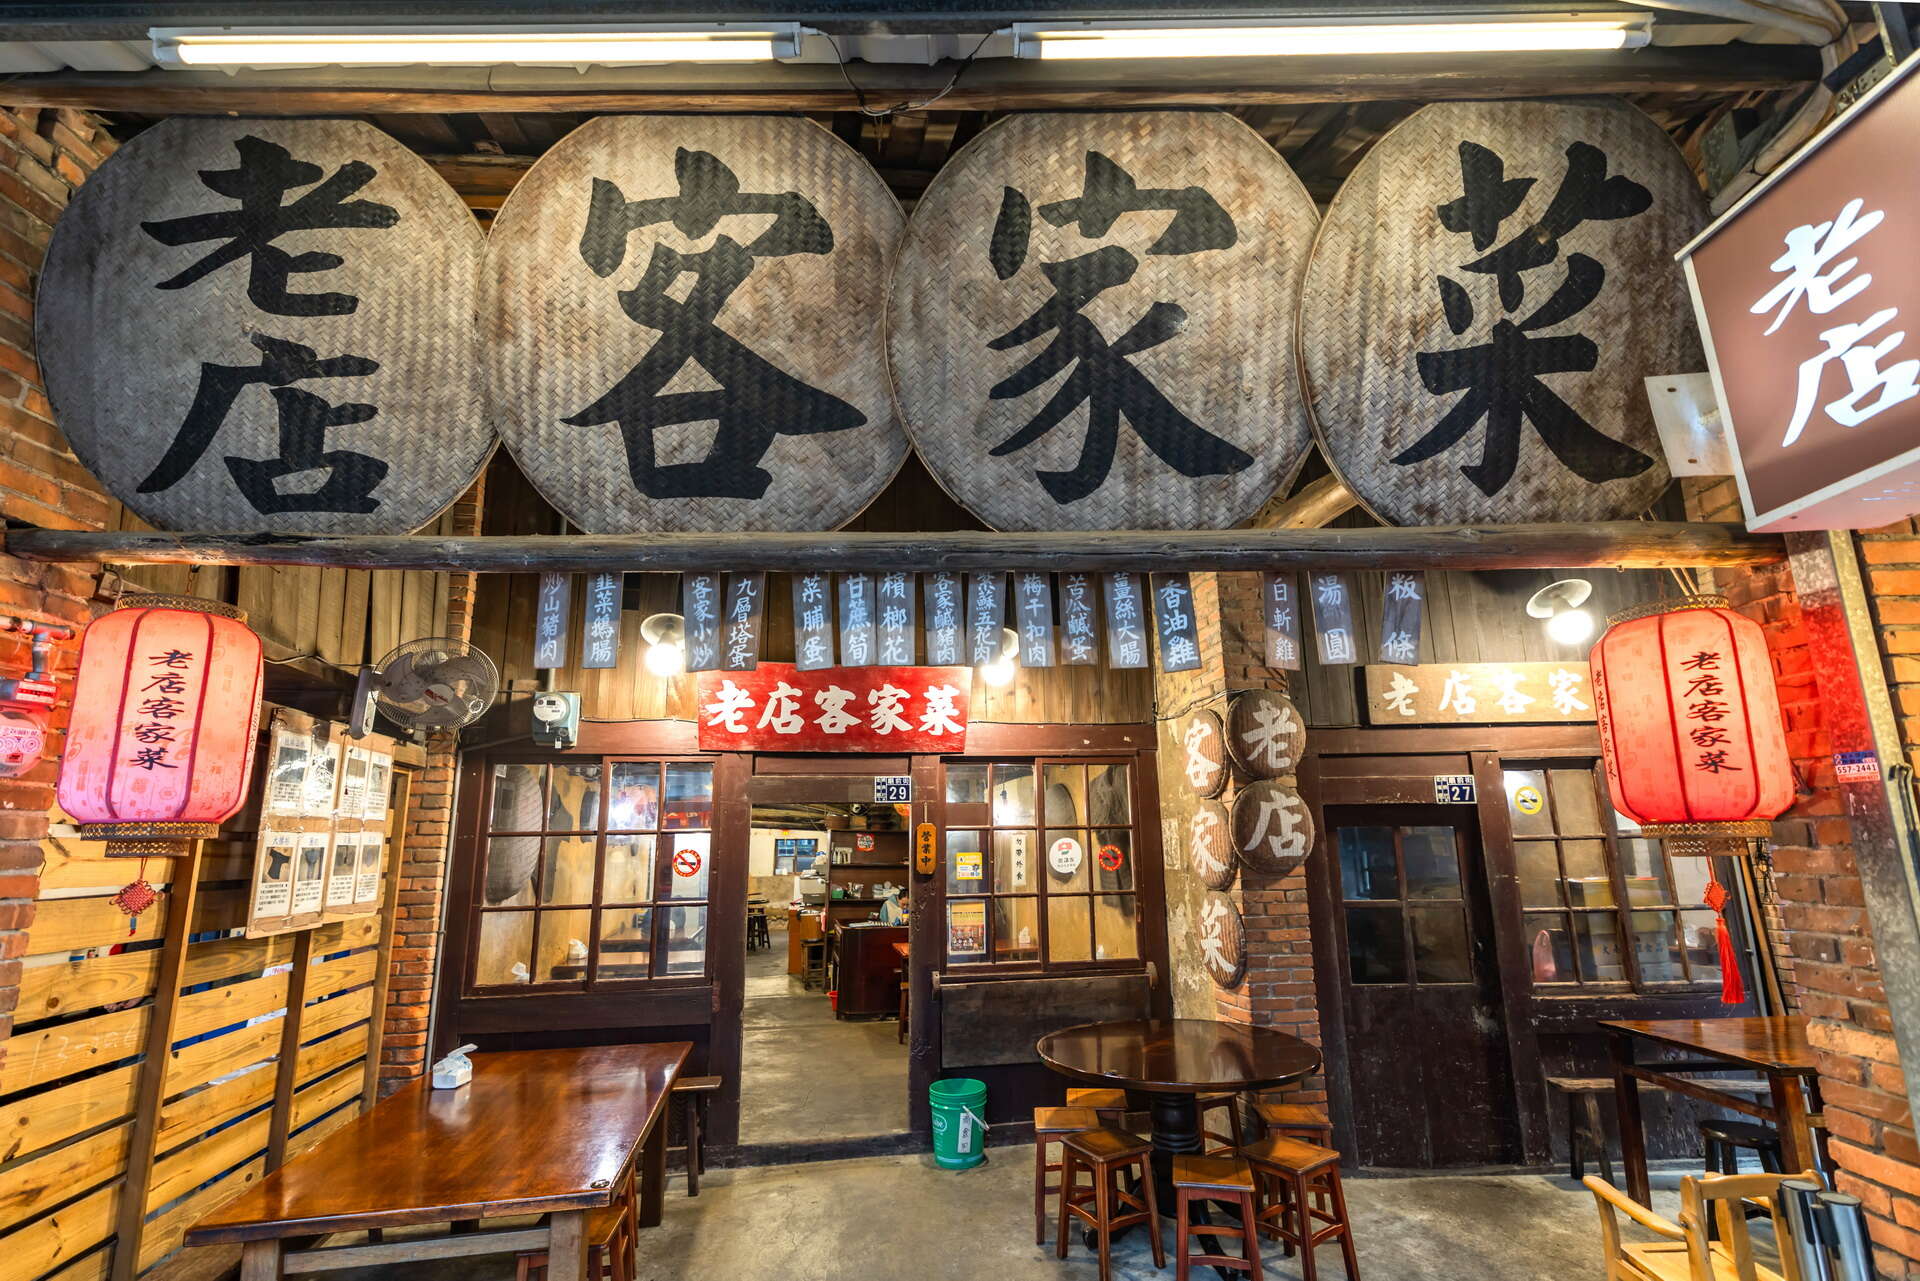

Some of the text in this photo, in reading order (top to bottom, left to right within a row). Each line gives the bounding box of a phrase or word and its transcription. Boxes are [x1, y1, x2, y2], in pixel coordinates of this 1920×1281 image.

[137, 134, 400, 514] 老店
[1750, 198, 1919, 448] 老店
[692, 576, 715, 667] 客家小炒
[728, 578, 757, 668] 九層塔蛋
[802, 574, 826, 665] 菜脯蛋
[844, 573, 871, 664] 甘蔗筍
[880, 572, 908, 664] 檳榔花
[1023, 573, 1046, 666] 梅干扣肉
[1160, 580, 1198, 668] 香油雞
[1272, 577, 1295, 662] 白斬雞
[1318, 575, 1349, 660] 湯圓
[1383, 573, 1421, 660] 粄條
[130, 649, 194, 770] 老店客家菜
[705, 680, 965, 735] 老店客家菜
[1680, 651, 1741, 774] 老店客家菜
[889, 786, 907, 800] 29
[1242, 701, 1306, 858] 老店
[1451, 785, 1471, 801] 27
[1184, 718, 1237, 974] 客家菜
